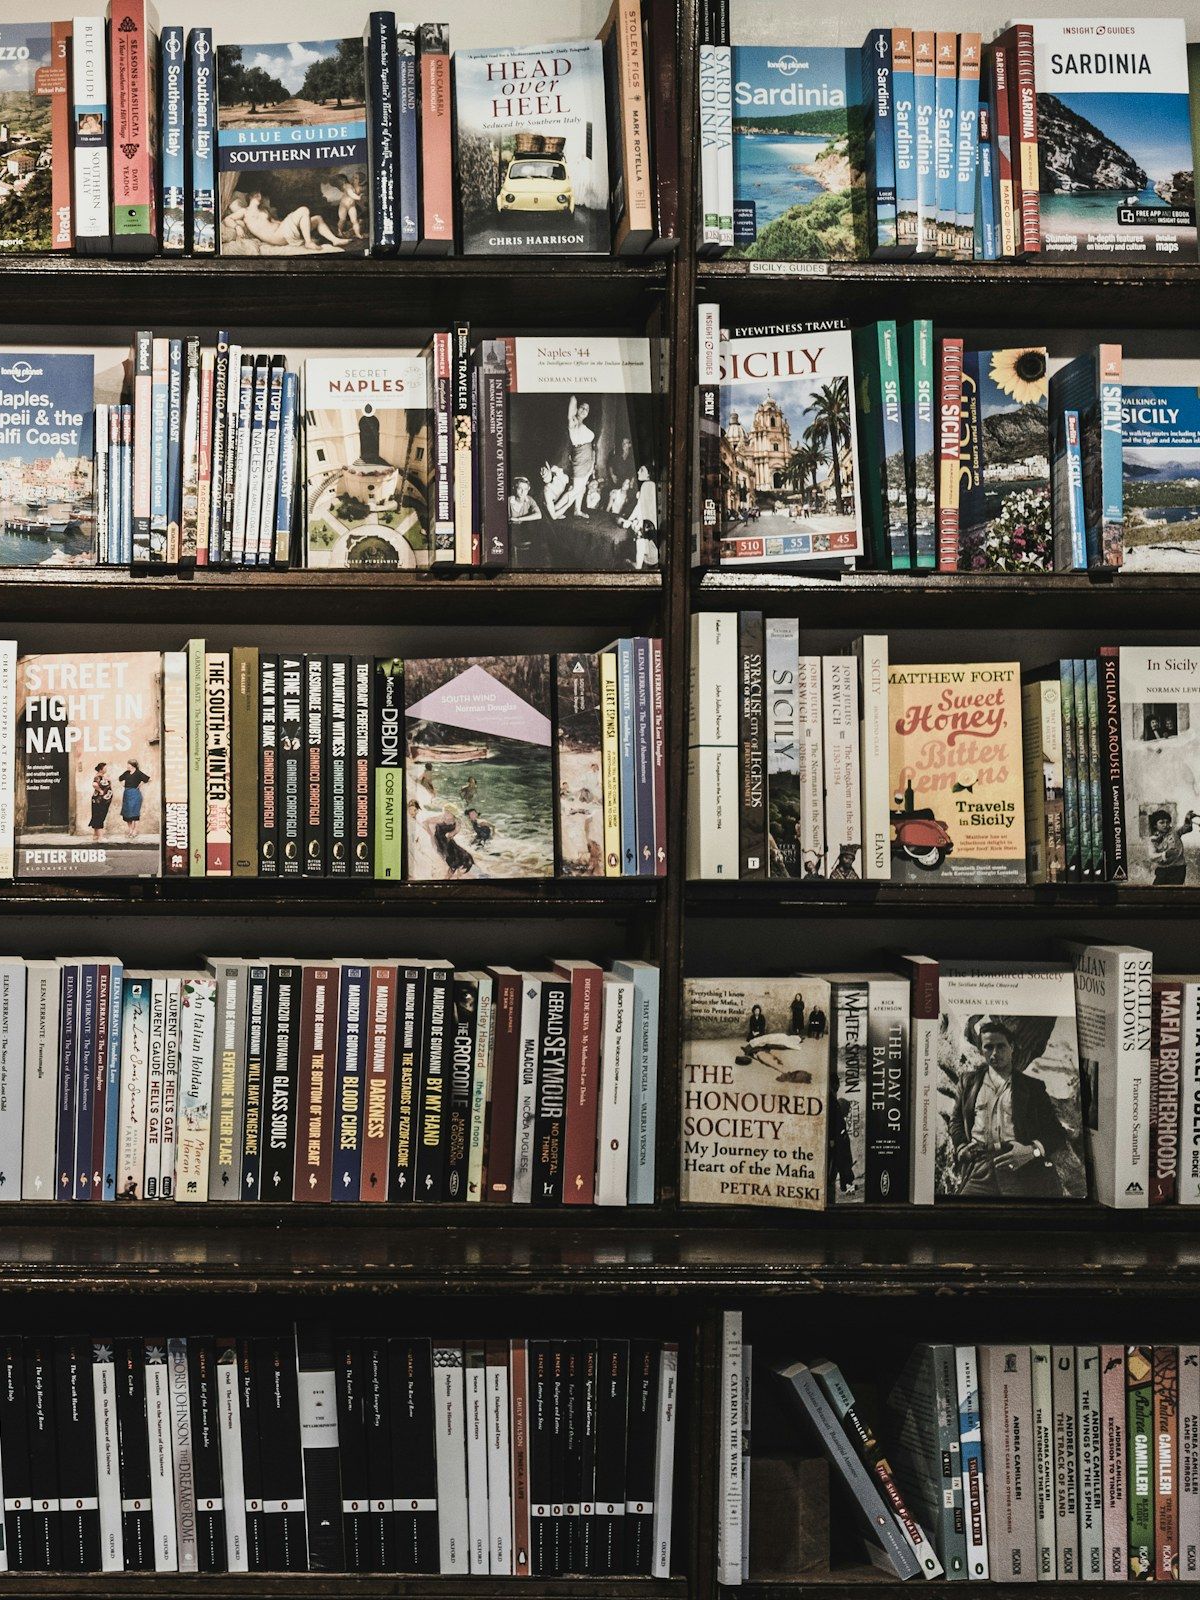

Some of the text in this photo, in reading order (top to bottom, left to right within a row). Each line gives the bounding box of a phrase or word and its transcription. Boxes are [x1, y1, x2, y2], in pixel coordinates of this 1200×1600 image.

[486, 59, 572, 82] HEAD
[1051, 54, 1151, 75] SARDINIA
[501, 79, 558, 94] over
[734, 83, 844, 106] Sardinia
[492, 94, 571, 116] HEEL
[238, 127, 348, 144] BLUE GUIDE
[230, 145, 356, 163] SOUTHERN ITALY
[489, 235, 584, 246] CHRIS HARRISON
[752, 263, 825, 273] SICILY: GUIDES
[537, 347, 571, 359] Naples
[344, 369, 388, 378] SECRET
[329, 380, 404, 392] NAPLES
[36, 410, 49, 424] &
[54, 409, 83, 425] the
[1122, 409, 1178, 424] SICILY
[26, 429, 78, 446] Coast
[940, 405, 960, 458] SICILY
[26, 662, 128, 690] STREET
[1148, 659, 1197, 674] In Sicily
[26, 693, 143, 722] FIGHT IN
[938, 690, 1004, 710] Sweet
[773, 669, 794, 759] SICILY
[1106, 662, 1119, 780] SICILIAN CAROUSEL
[209, 661, 225, 800] THE SOUTH WINTER
[381, 709, 398, 765] DIBDIN
[897, 707, 1007, 745] Honey,
[26, 725, 131, 752] NAPLES
[956, 801, 1015, 814] Travels
[959, 814, 1015, 828] in Sicily
[26, 849, 106, 864] PETER ROBB
[1123, 961, 1135, 1052] SHADOWS
[1137, 961, 1152, 1052] SICILIAN
[685, 1064, 733, 1084] THE
[270, 1076, 289, 1149] GLASS SOULS
[368, 1079, 386, 1139] DARKNESS
[685, 1091, 823, 1116] HONOURED
[684, 1117, 784, 1140] SOCIETY
[720, 1182, 820, 1200] PETRA RESKI
[174, 1358, 190, 1446] BORIS JOHNSON
[1135, 1434, 1148, 1496] CAMILLERI
[1014, 1455, 1022, 1500] CAMILLERI
